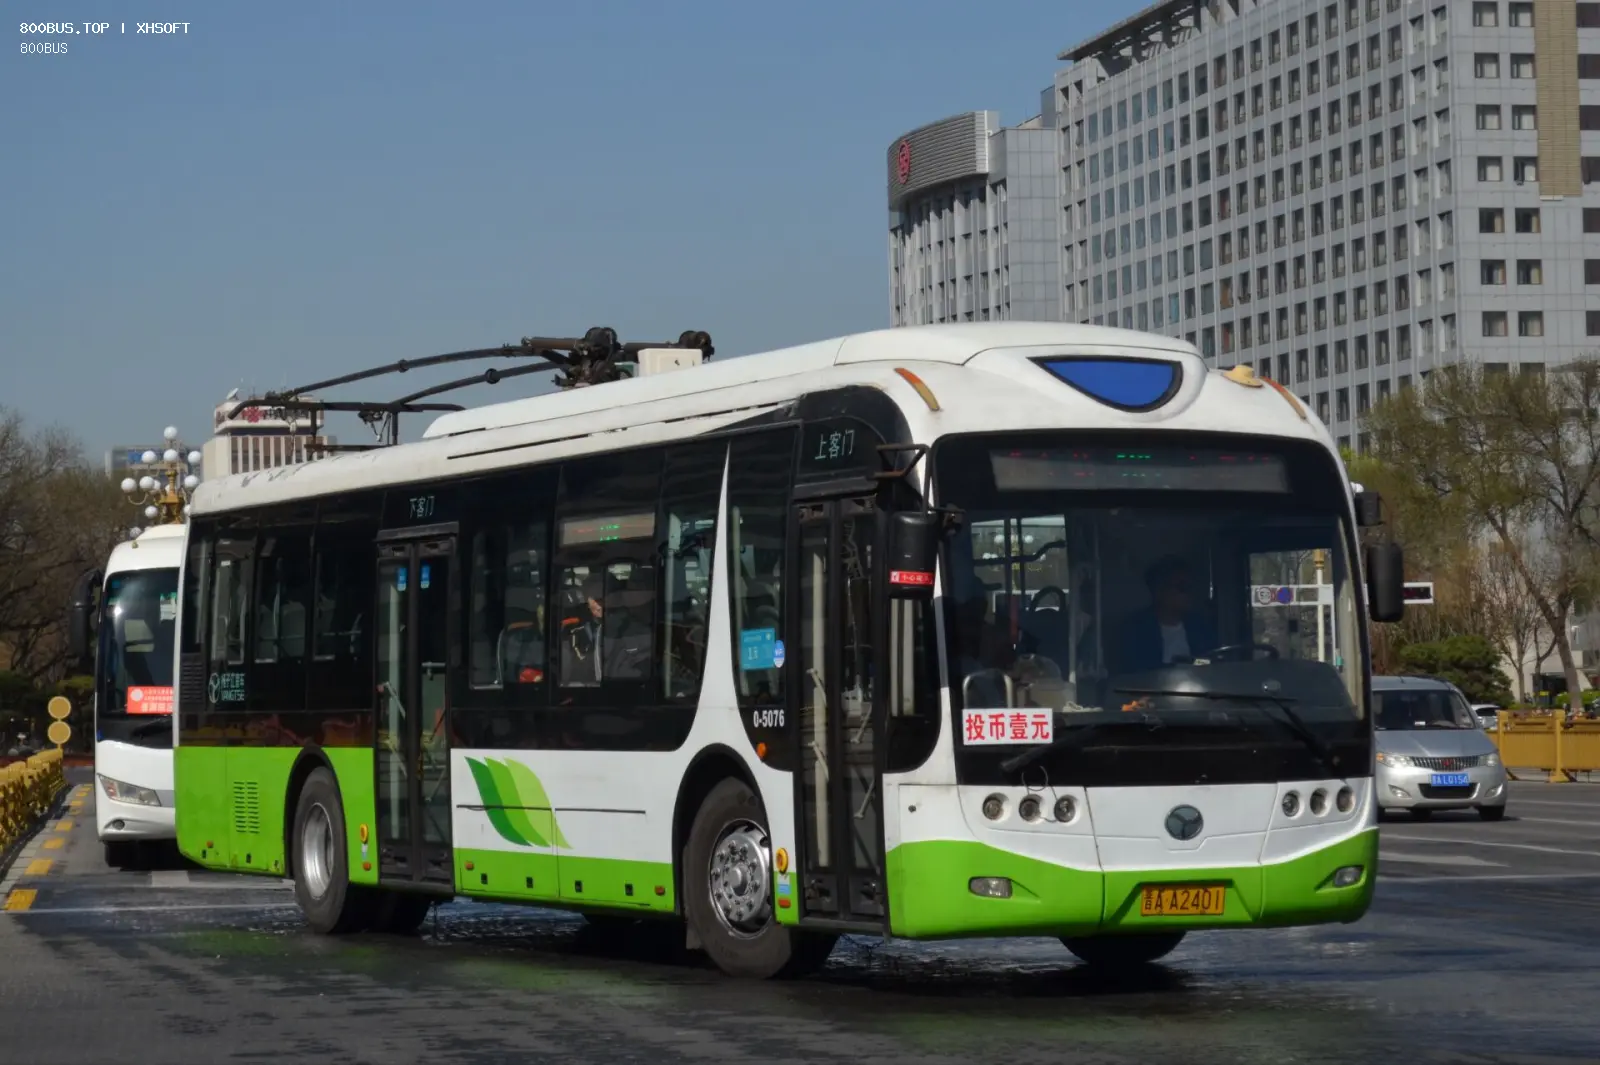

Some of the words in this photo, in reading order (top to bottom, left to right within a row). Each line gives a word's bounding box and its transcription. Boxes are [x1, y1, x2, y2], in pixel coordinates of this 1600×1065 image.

[814, 430, 854, 460] 上客门
[409, 496, 435, 519] 下客门
[753, 709, 785, 728] 0-5076
[965, 712, 1050, 741] 投币壹元
